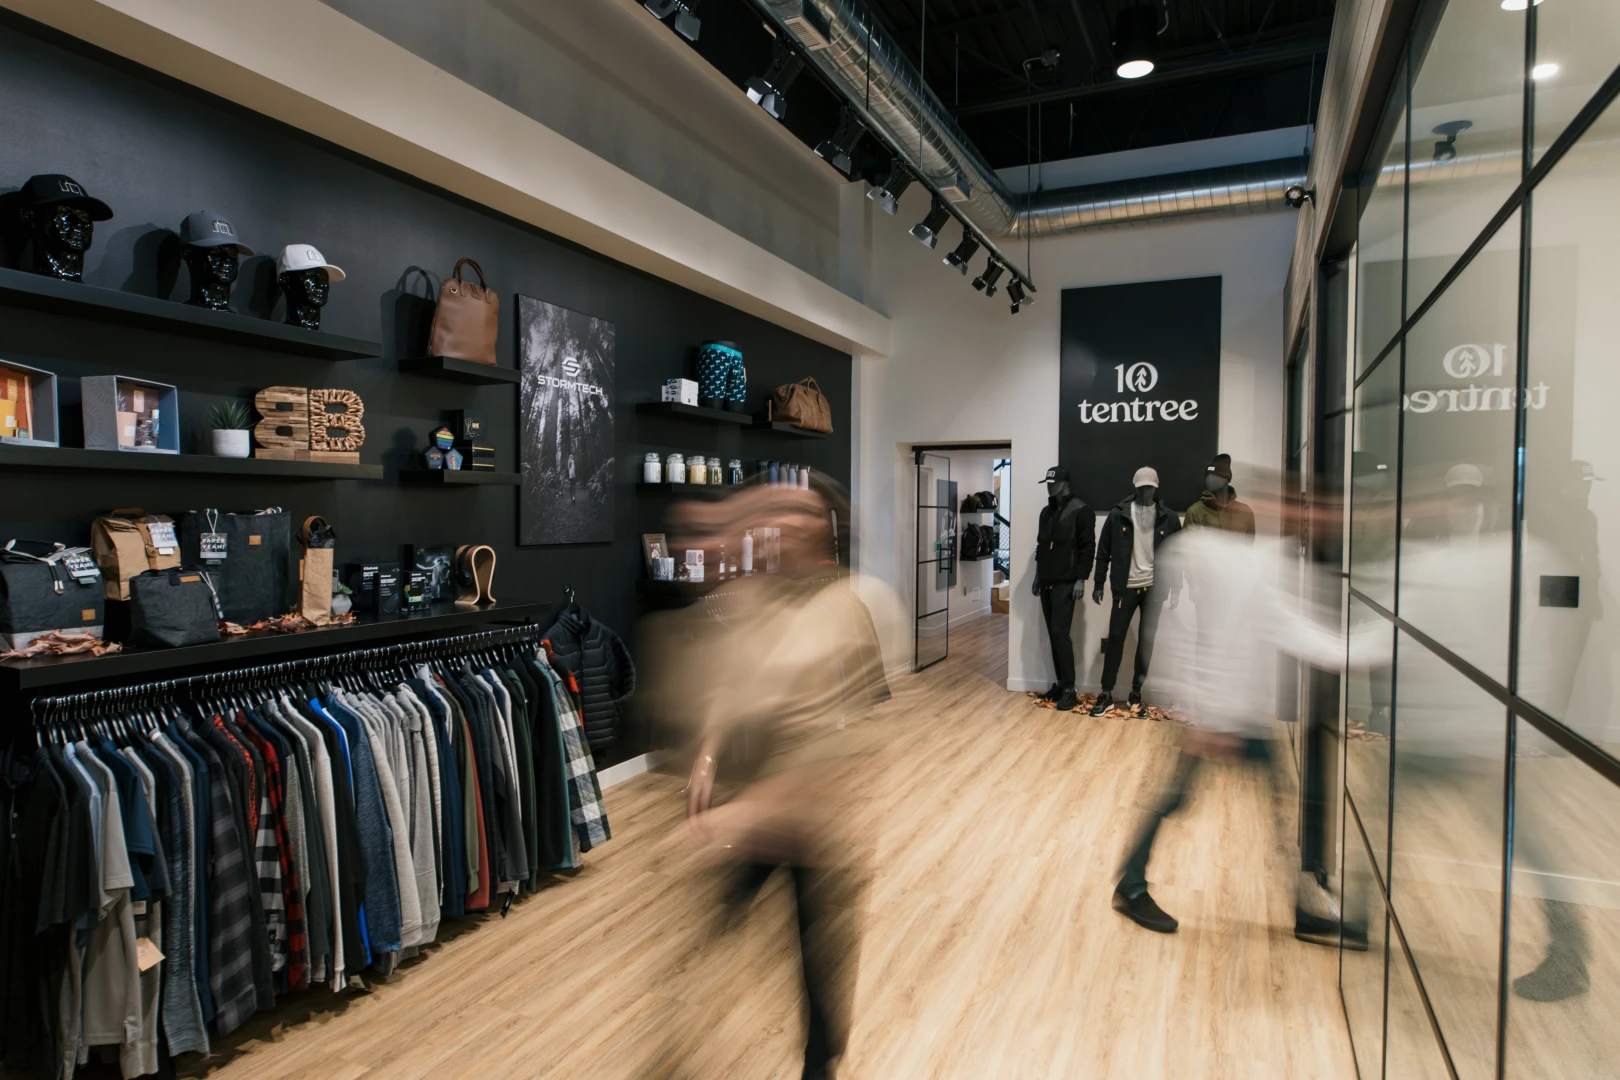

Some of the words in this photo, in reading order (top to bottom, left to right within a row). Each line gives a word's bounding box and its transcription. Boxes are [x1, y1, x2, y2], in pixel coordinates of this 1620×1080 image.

[537, 374, 603, 395] STORMTECH
[1114, 362, 1158, 393] 10
[1078, 397, 1198, 423] tentree
